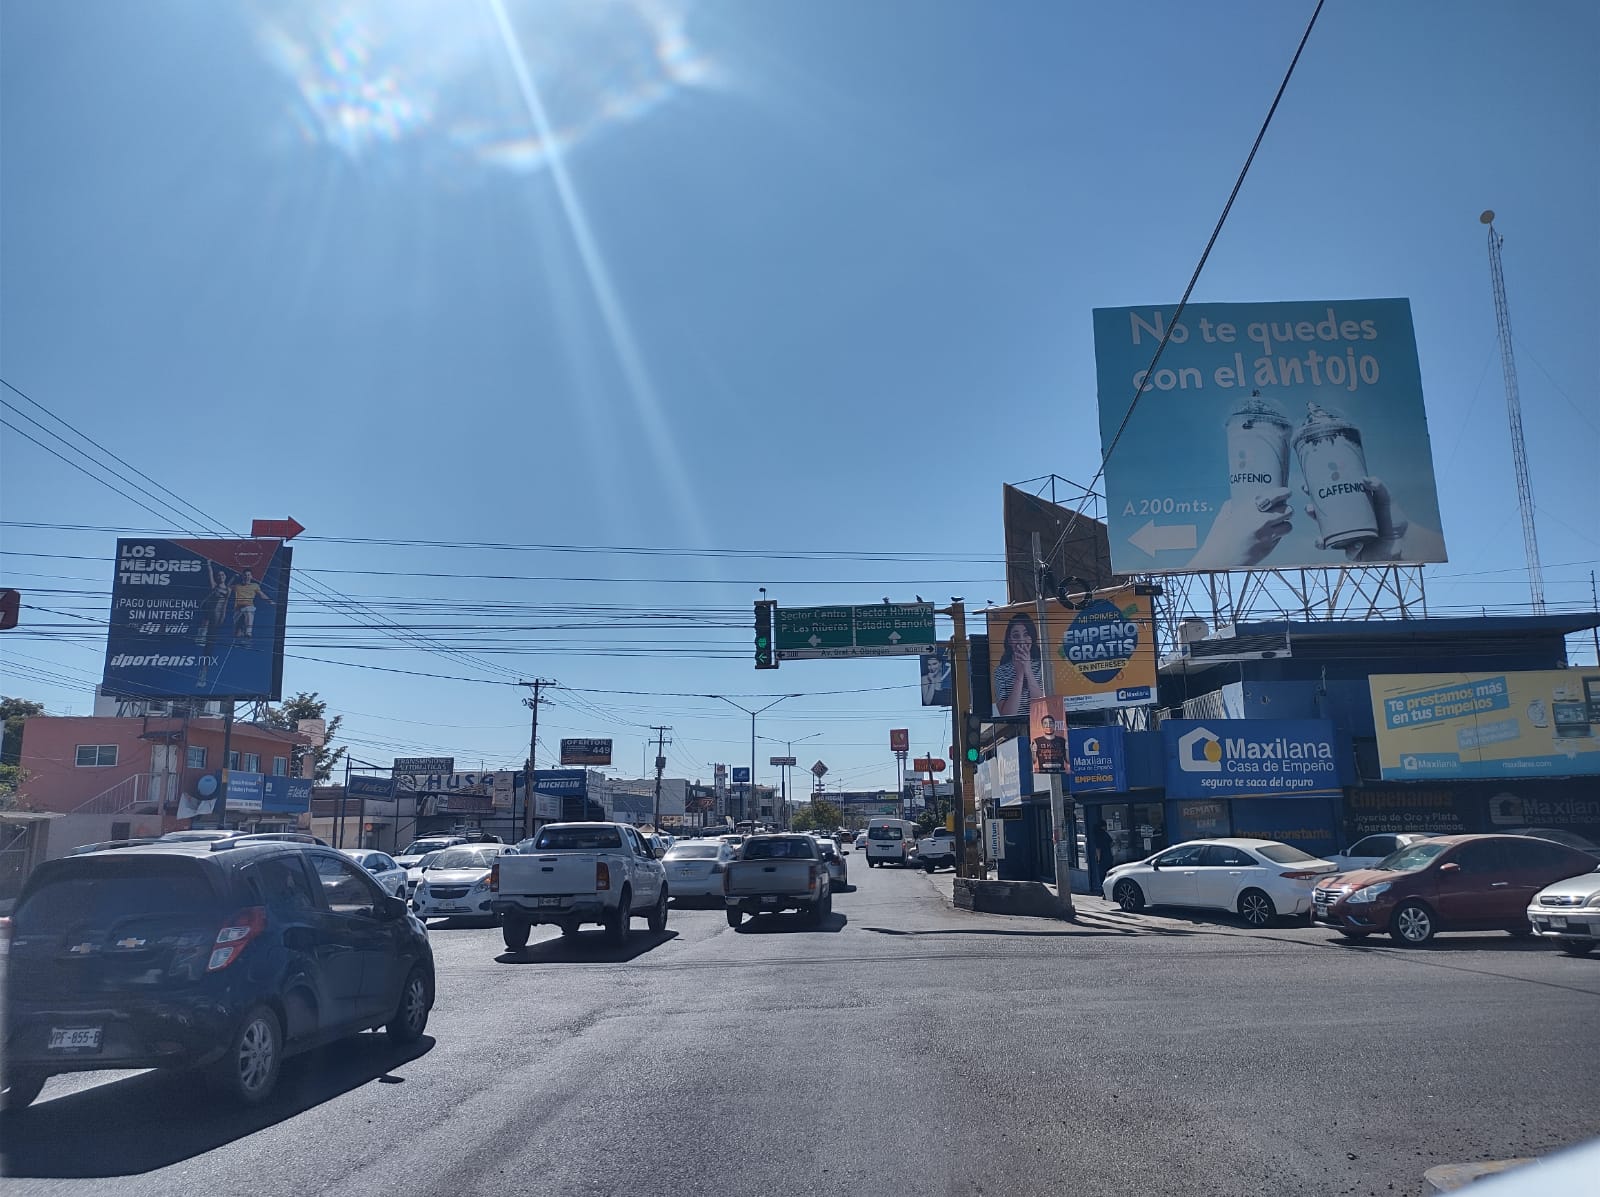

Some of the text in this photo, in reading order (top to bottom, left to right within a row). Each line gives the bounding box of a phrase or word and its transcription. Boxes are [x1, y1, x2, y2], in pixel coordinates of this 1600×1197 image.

[1129, 307, 1378, 356] No te quedes
[1132, 347, 1380, 392] con el antojo
[1230, 472, 1272, 484] CAFFENIO
[1318, 482, 1366, 499] CAFFENIO
[1122, 497, 1214, 516] A 200 mts.
[121, 544, 156, 558] LOS
[119, 558, 202, 573] MEJORES
[119, 572, 171, 586] TENIS
[146, 599, 199, 609] QUINCENAL
[856, 604, 932, 617] Sector Humaya
[129, 607, 194, 620] SIN INTERÉS!
[781, 611, 812, 620] Sector
[793, 624, 809, 633] Las
[856, 619, 892, 630] Estadio
[1064, 619, 1138, 645] EMPEÑO
[1069, 638, 1135, 661] GRATIS
[1389, 682, 1503, 712] Te prestamos más
[1392, 712, 1410, 725] en
[1411, 708, 1433, 721] tus
[1225, 737, 1334, 760] Maxilana
[1073, 756, 1113, 767] Maxilana
[1226, 759, 1335, 774] Casa de Empeño
[538, 780, 581, 789] MICHELIN
[1201, 776, 1314, 790] seguro te saca del apuro
